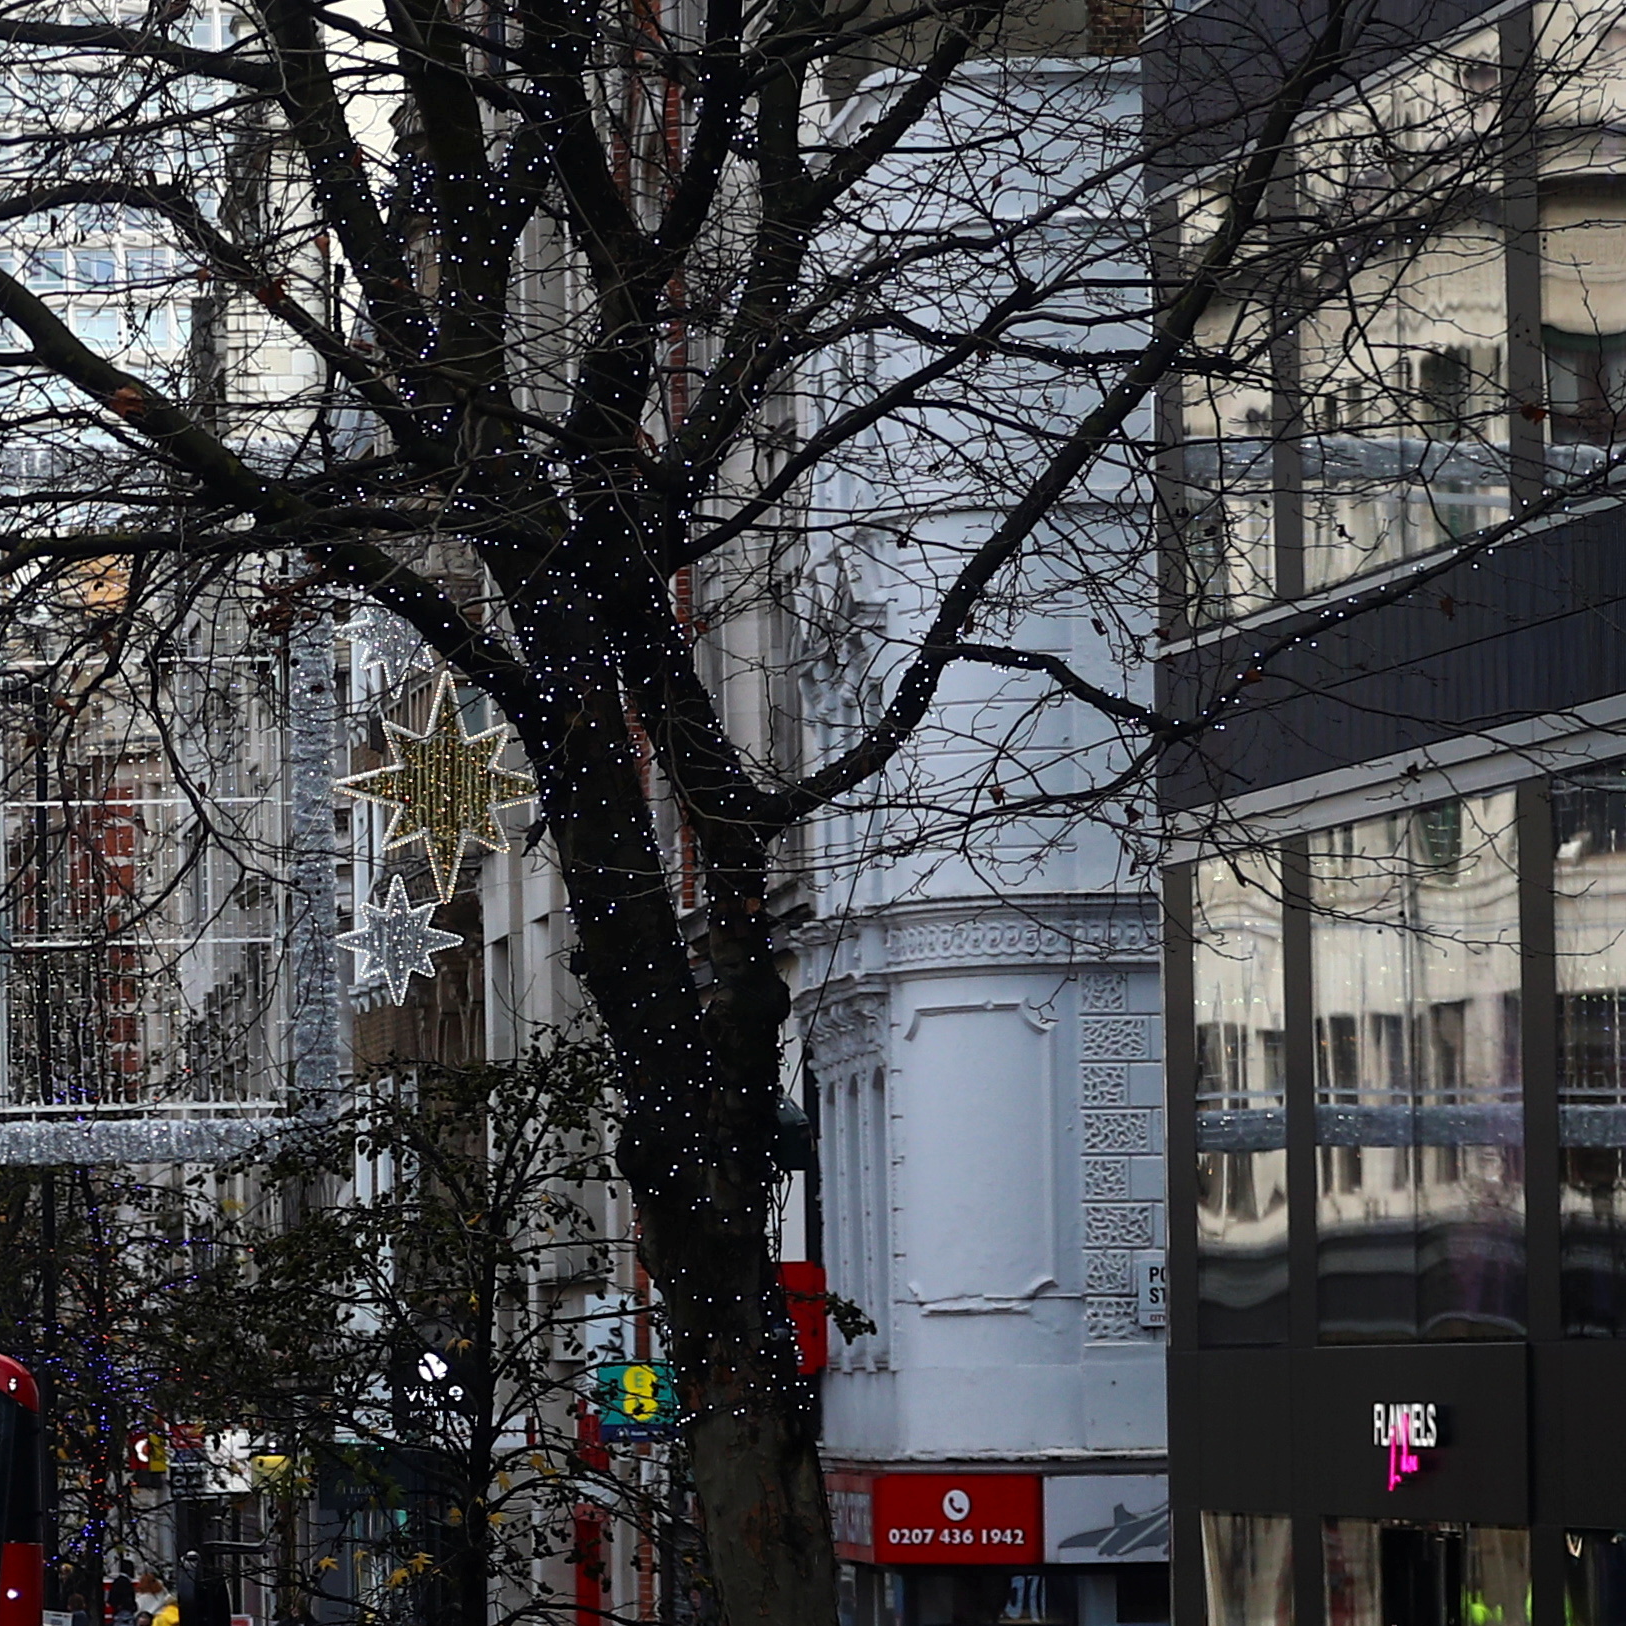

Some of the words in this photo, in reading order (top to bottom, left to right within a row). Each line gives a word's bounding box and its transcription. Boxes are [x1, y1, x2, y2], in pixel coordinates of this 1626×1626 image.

[888, 1529, 934, 1545] 0207
[939, 1529, 975, 1545] 436
[981, 1529, 1025, 1545] 1942
